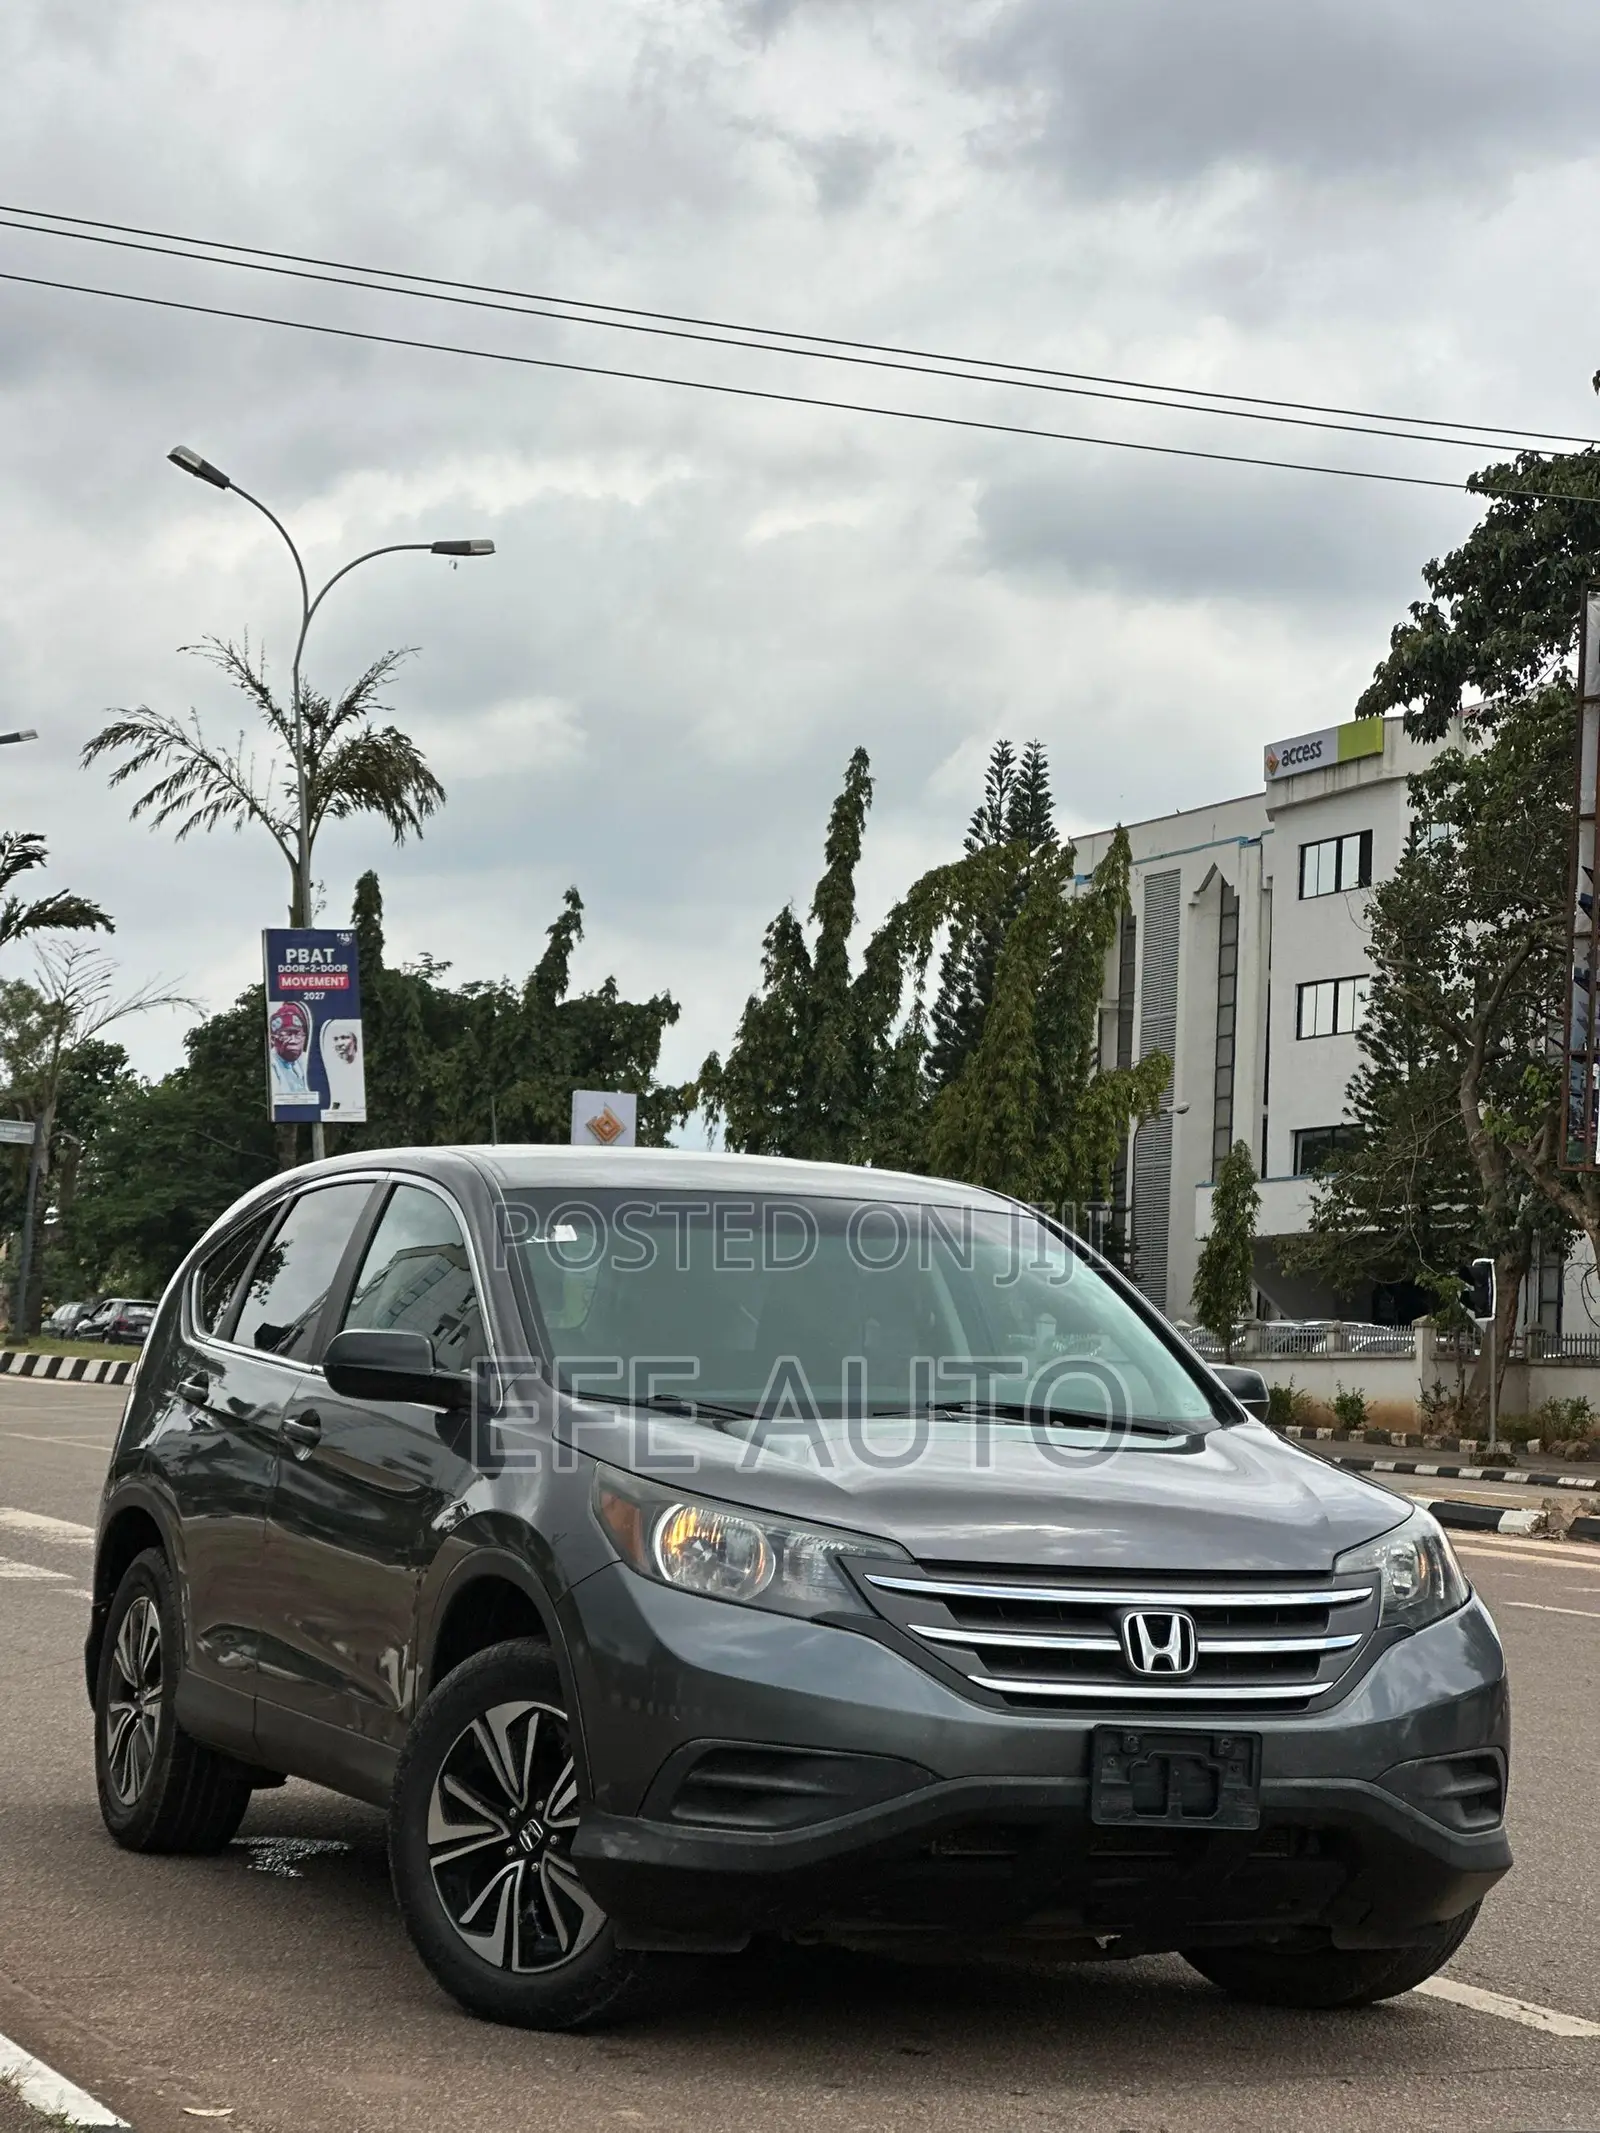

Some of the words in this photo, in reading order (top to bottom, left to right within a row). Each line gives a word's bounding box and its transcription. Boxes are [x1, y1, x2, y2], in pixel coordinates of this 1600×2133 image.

[1281, 741, 1323, 767] access
[285, 948, 335, 963] PBAT
[277, 964, 348, 973] DOOR-2-DOOR
[281, 976, 345, 987] MOVEMENT
[303, 992, 326, 1001] 2027
